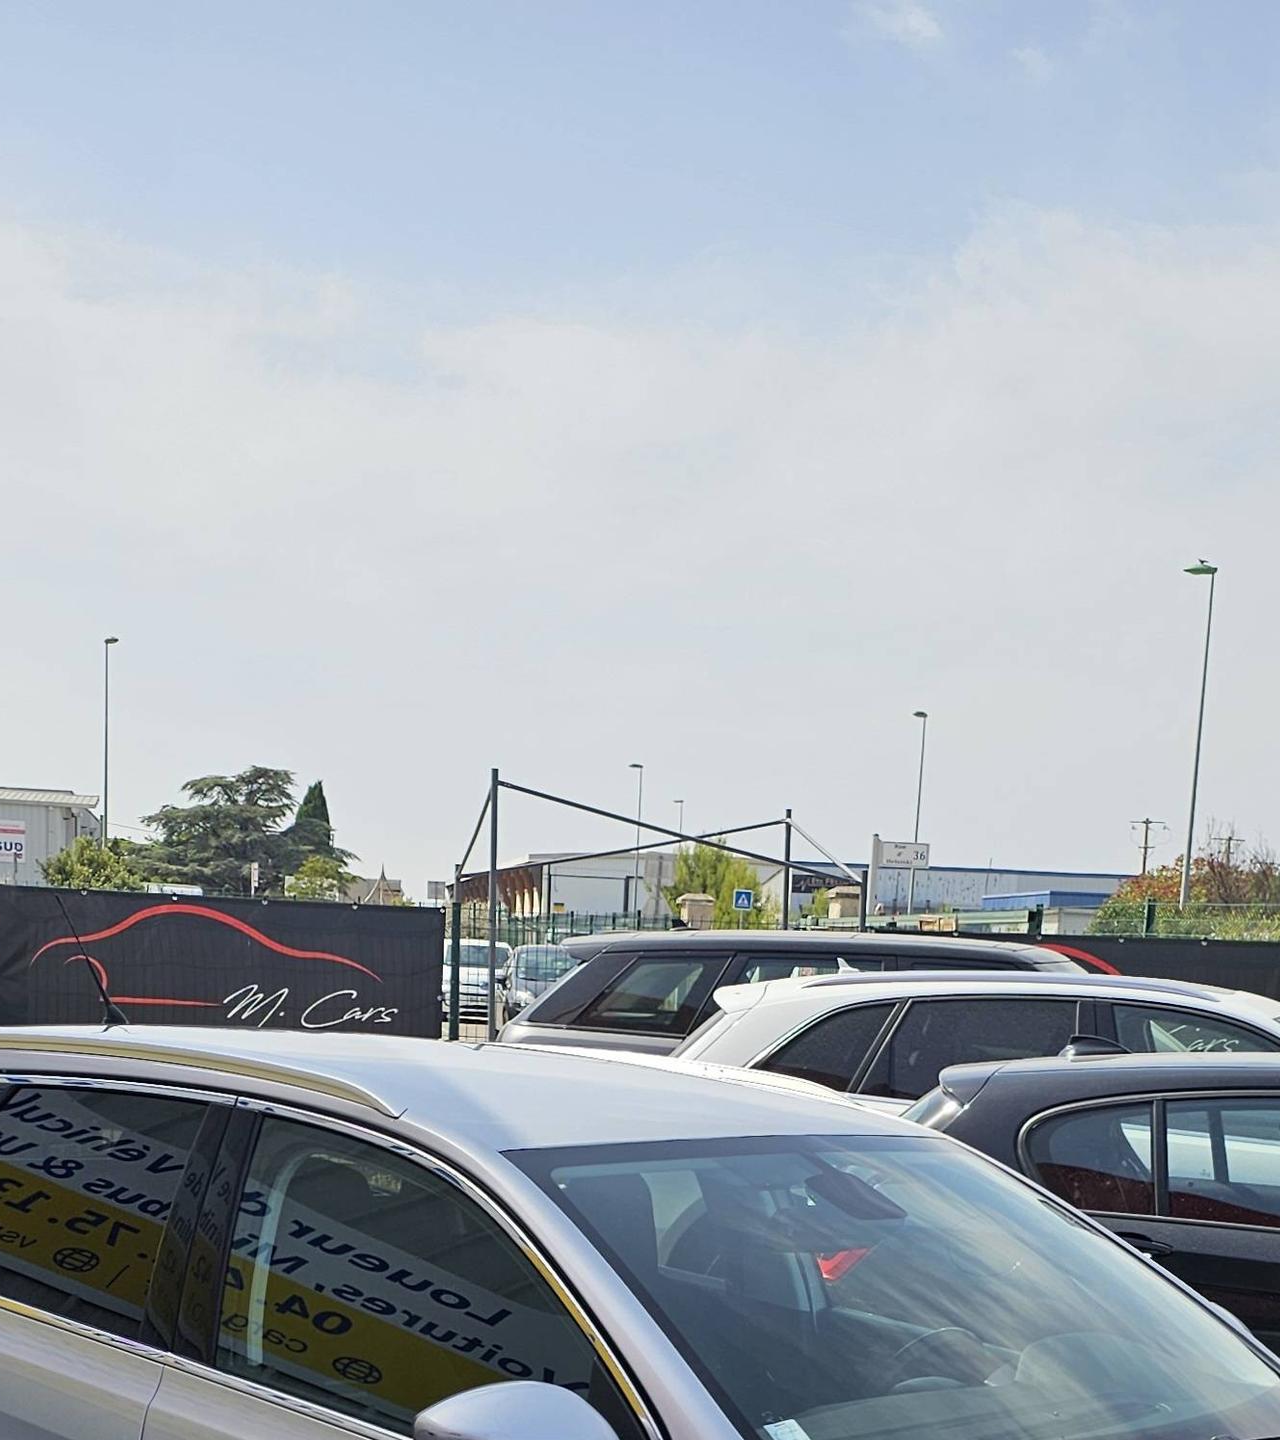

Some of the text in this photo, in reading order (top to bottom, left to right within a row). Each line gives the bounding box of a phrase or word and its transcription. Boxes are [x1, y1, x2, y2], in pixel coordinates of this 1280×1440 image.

[913, 850, 926, 860] 36
[222, 984, 399, 1028] M. Cars
